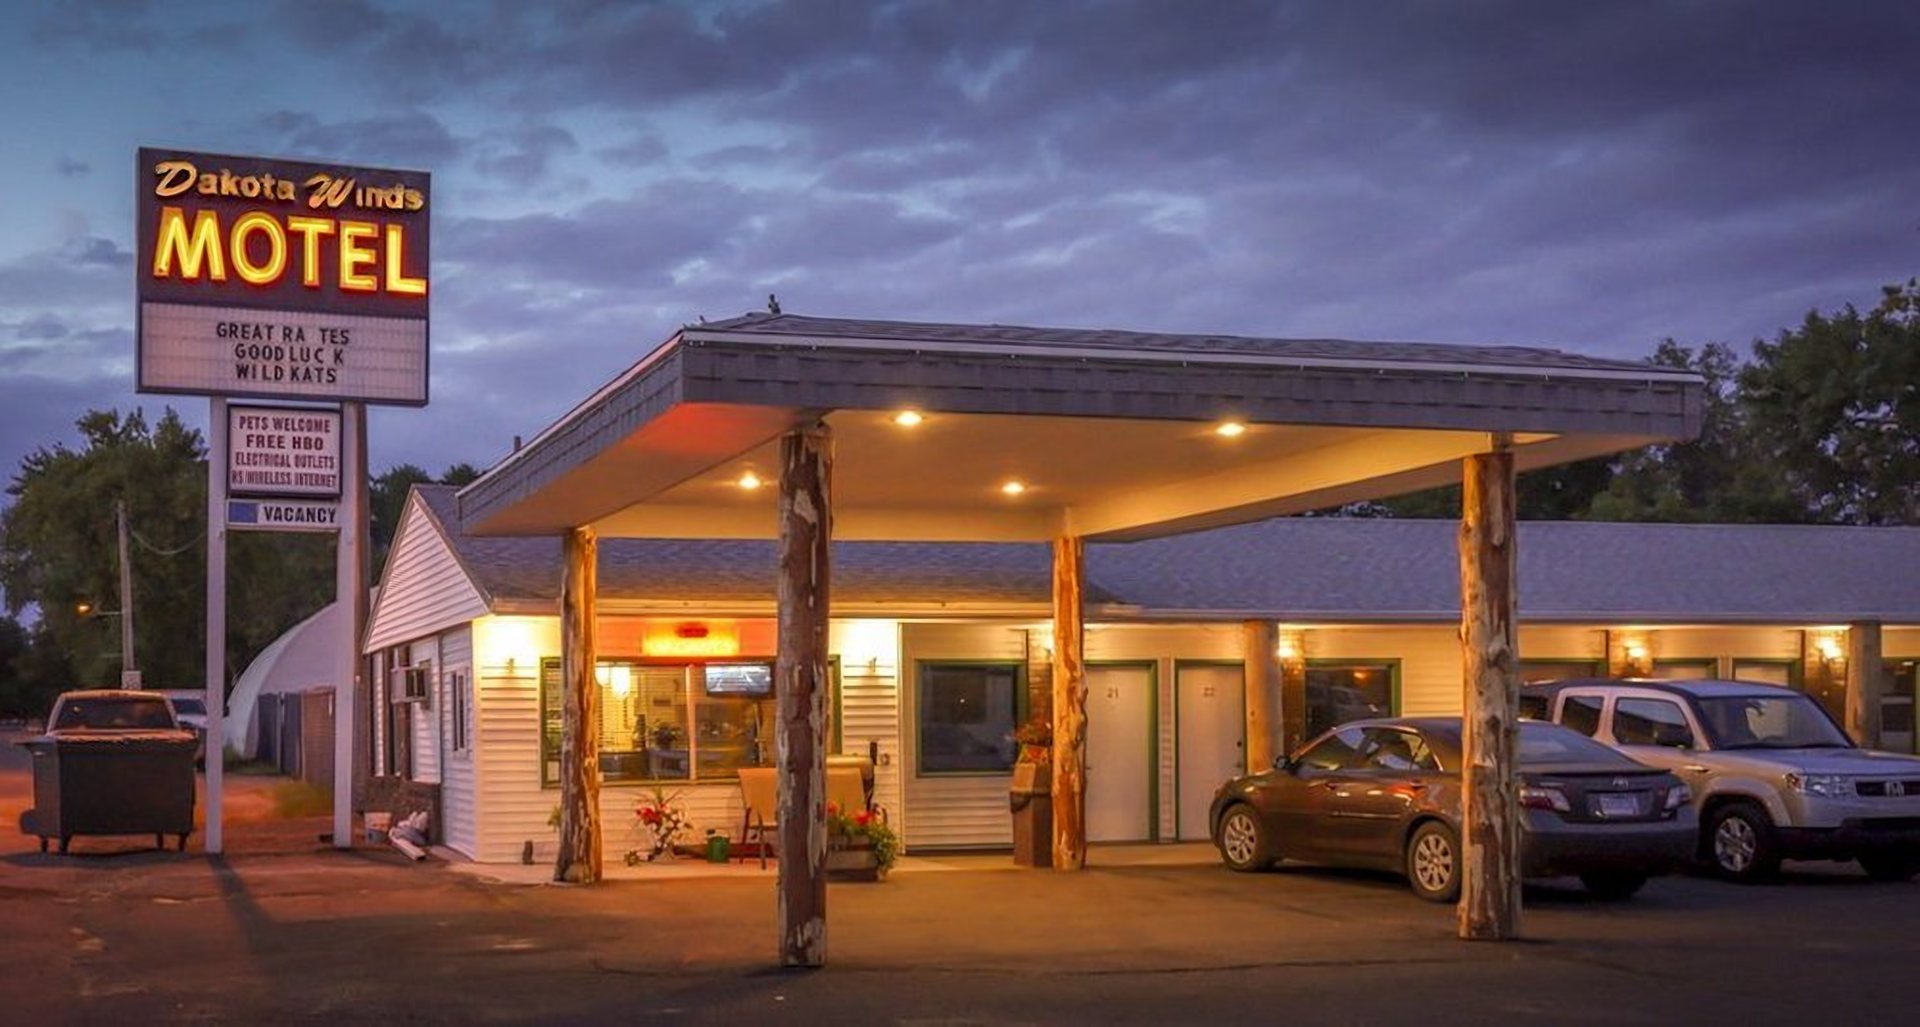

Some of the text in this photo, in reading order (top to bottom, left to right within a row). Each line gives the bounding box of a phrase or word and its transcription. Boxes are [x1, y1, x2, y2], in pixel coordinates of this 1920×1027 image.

[154, 160, 424, 211] Dakota Winds
[153, 206, 427, 295] MOTEL
[216, 322, 274, 341] GREAT
[235, 343, 285, 361] GOOD
[239, 415, 331, 433] PETS WELCOME
[246, 434, 324, 451] FREE HBO
[235, 452, 335, 470] ELECTRICAL OUTLETS
[263, 505, 337, 523] VACANCY
